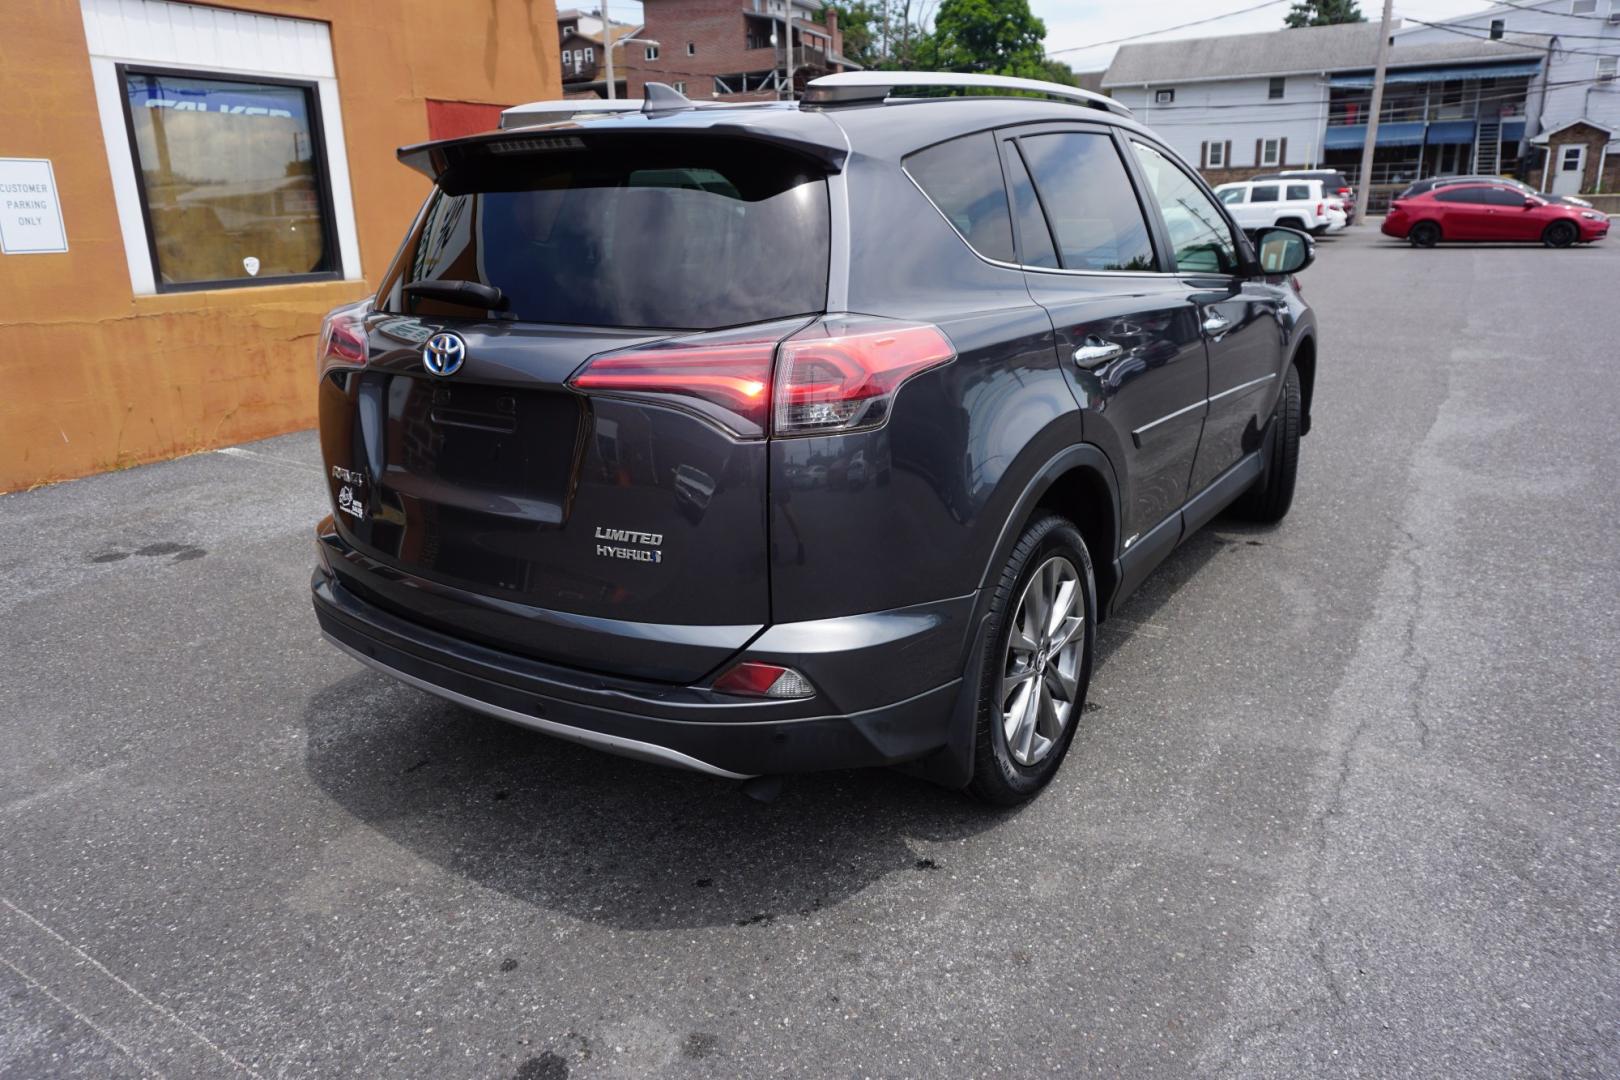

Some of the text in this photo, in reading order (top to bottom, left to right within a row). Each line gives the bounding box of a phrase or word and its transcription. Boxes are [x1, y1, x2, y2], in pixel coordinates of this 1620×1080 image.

[0, 184, 48, 193] CUSTOMER
[7, 200, 47, 209] PARKING
[18, 216, 42, 226] ONLY
[595, 526, 663, 546] LIMITED
[596, 544, 653, 562] HYBRID
